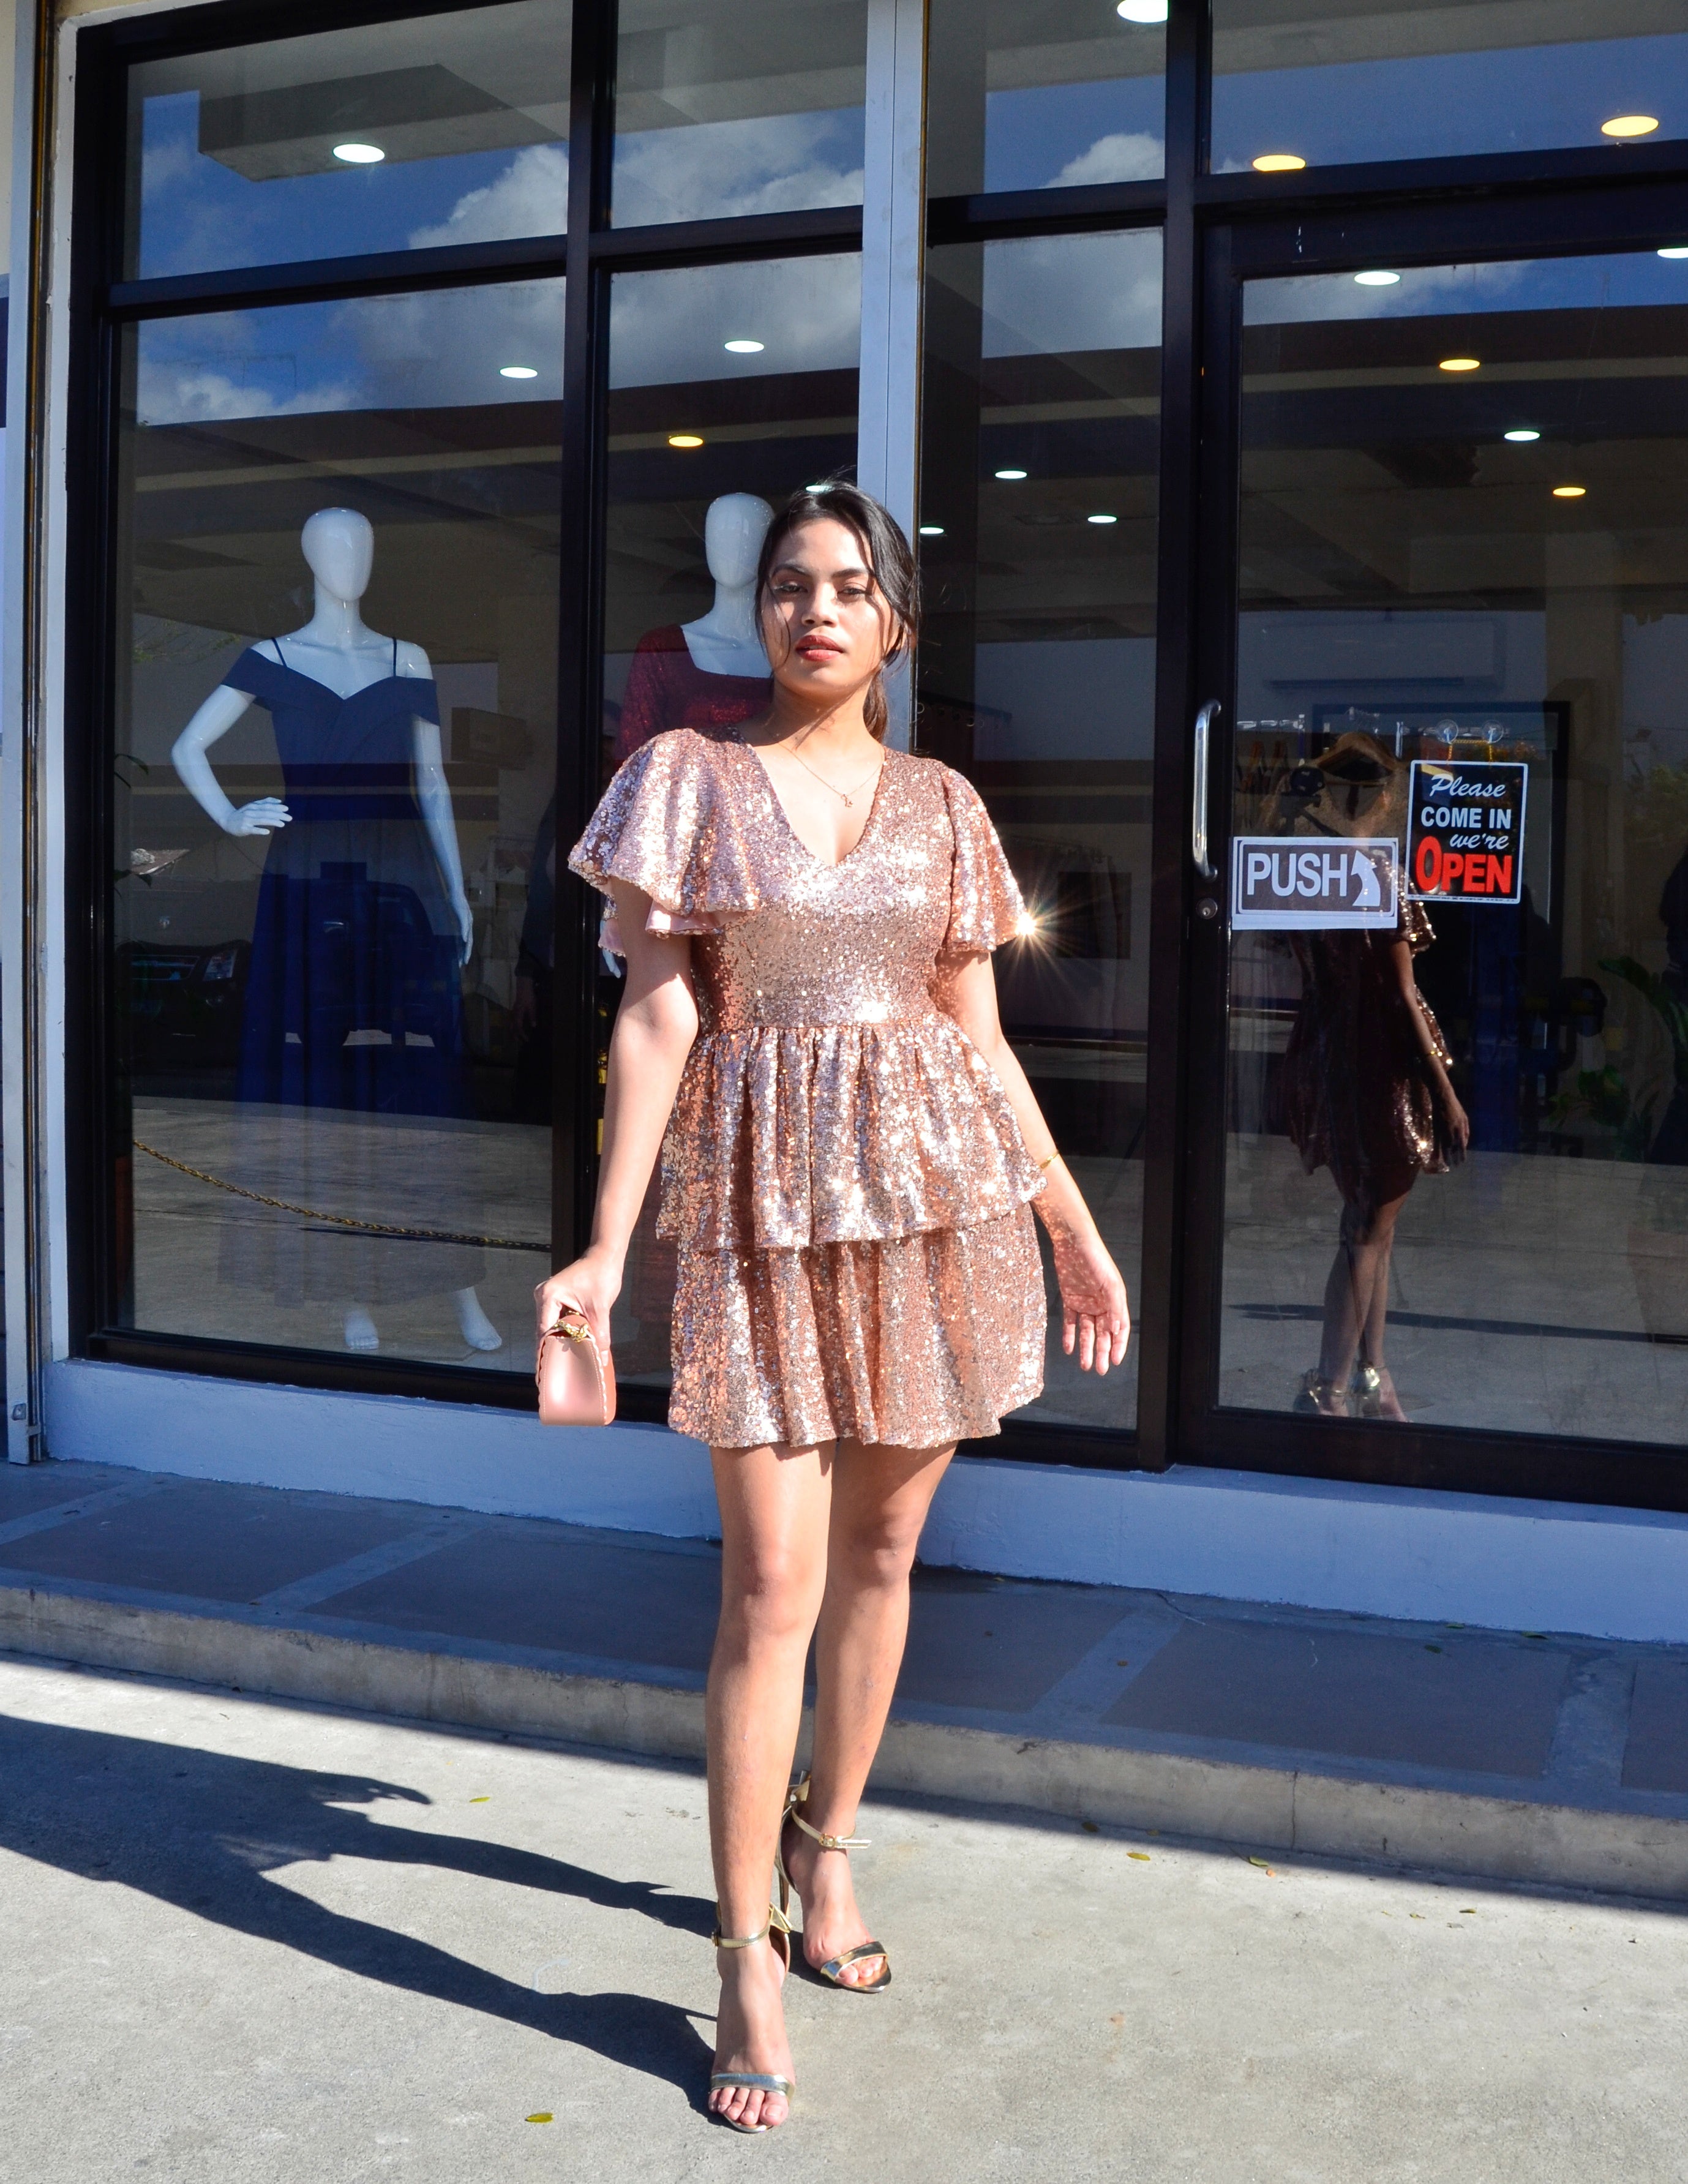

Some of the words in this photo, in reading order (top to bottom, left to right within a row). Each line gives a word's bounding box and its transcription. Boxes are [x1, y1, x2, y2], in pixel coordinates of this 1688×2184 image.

[1430, 774, 1506, 797] Please
[1421, 806, 1482, 828] COME
[1489, 808, 1512, 829] IN
[1450, 833, 1509, 849] we're
[1247, 853, 1347, 896] PUSH
[1416, 836, 1512, 894] OPEN
